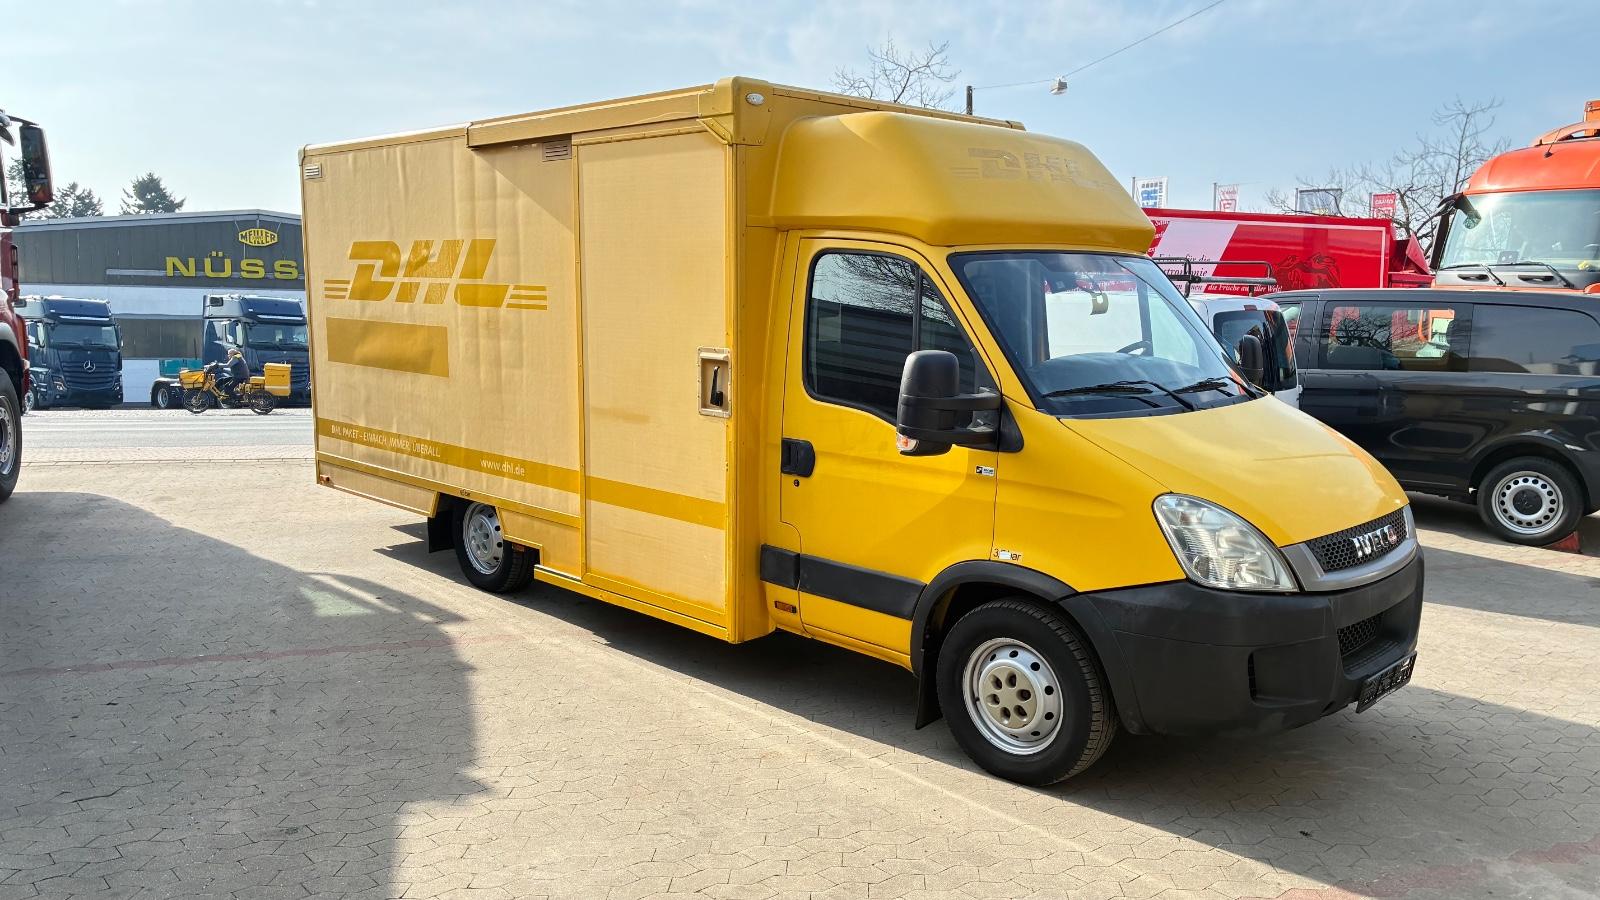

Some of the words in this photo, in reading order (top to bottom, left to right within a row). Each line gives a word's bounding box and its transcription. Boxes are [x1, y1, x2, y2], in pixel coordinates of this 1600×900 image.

[240, 229, 276, 245] MEILLER
[348, 238, 510, 308] DHL
[331, 424, 341, 435] DHL
[342, 427, 359, 440] PAKET
[480, 458, 526, 476] www.dhl.de
[1349, 524, 1397, 558] IVECO
